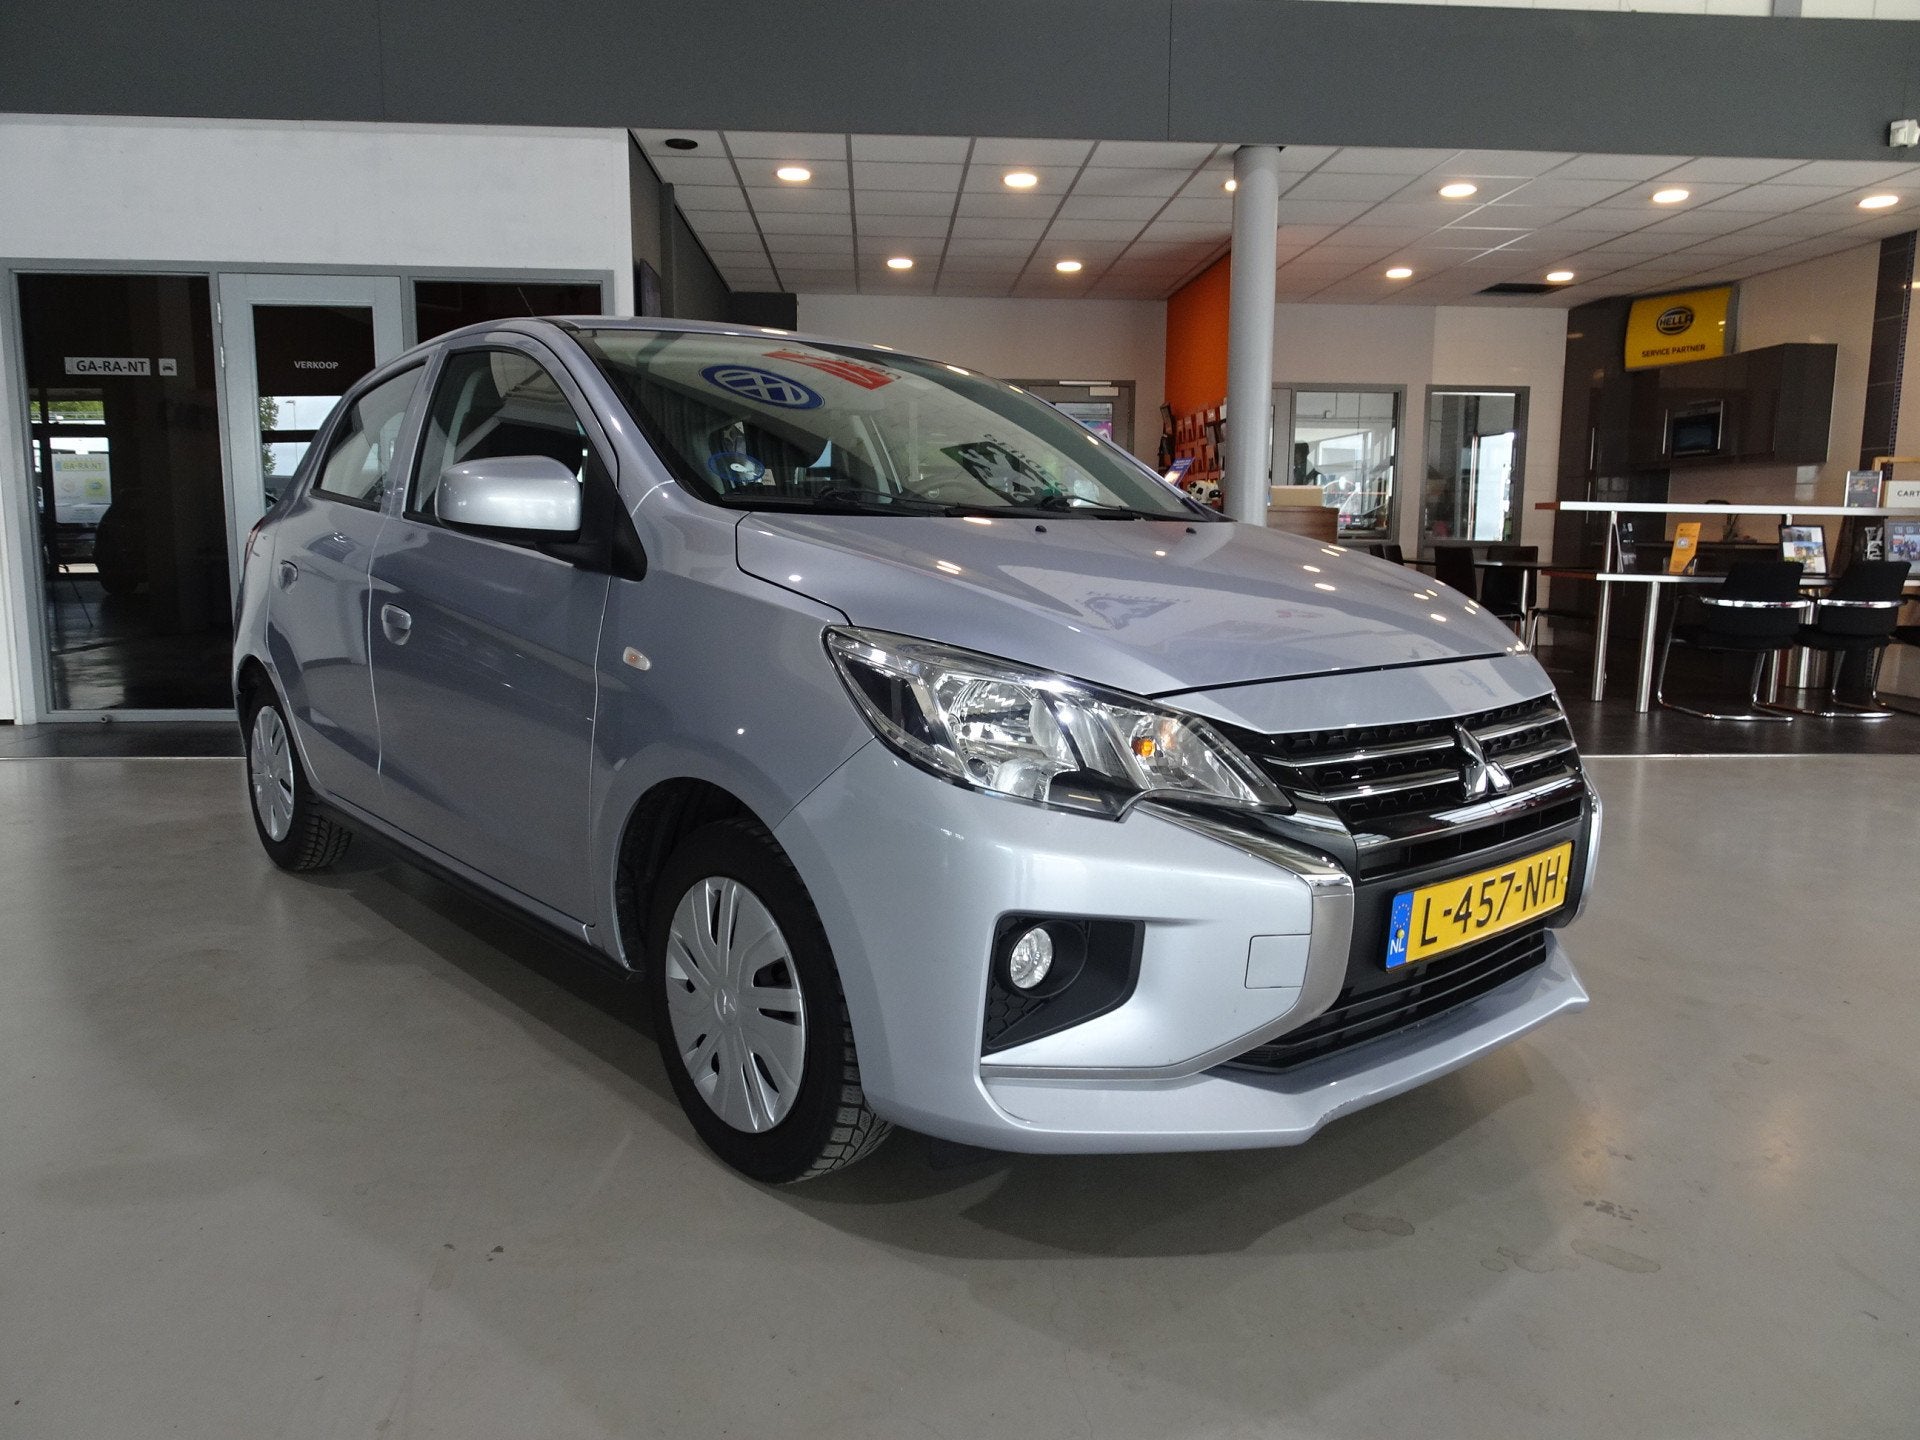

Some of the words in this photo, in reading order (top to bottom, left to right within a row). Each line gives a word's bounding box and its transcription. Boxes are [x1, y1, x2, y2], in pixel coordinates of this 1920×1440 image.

[1641, 346, 1670, 358] SERVICE
[1672, 343, 1706, 354] PARTNER
[76, 360, 146, 373] GA-RA-NT
[293, 360, 339, 369] VERKOOP
[1419, 855, 1562, 948] L-457-NH
[1389, 938, 1405, 955] NL
